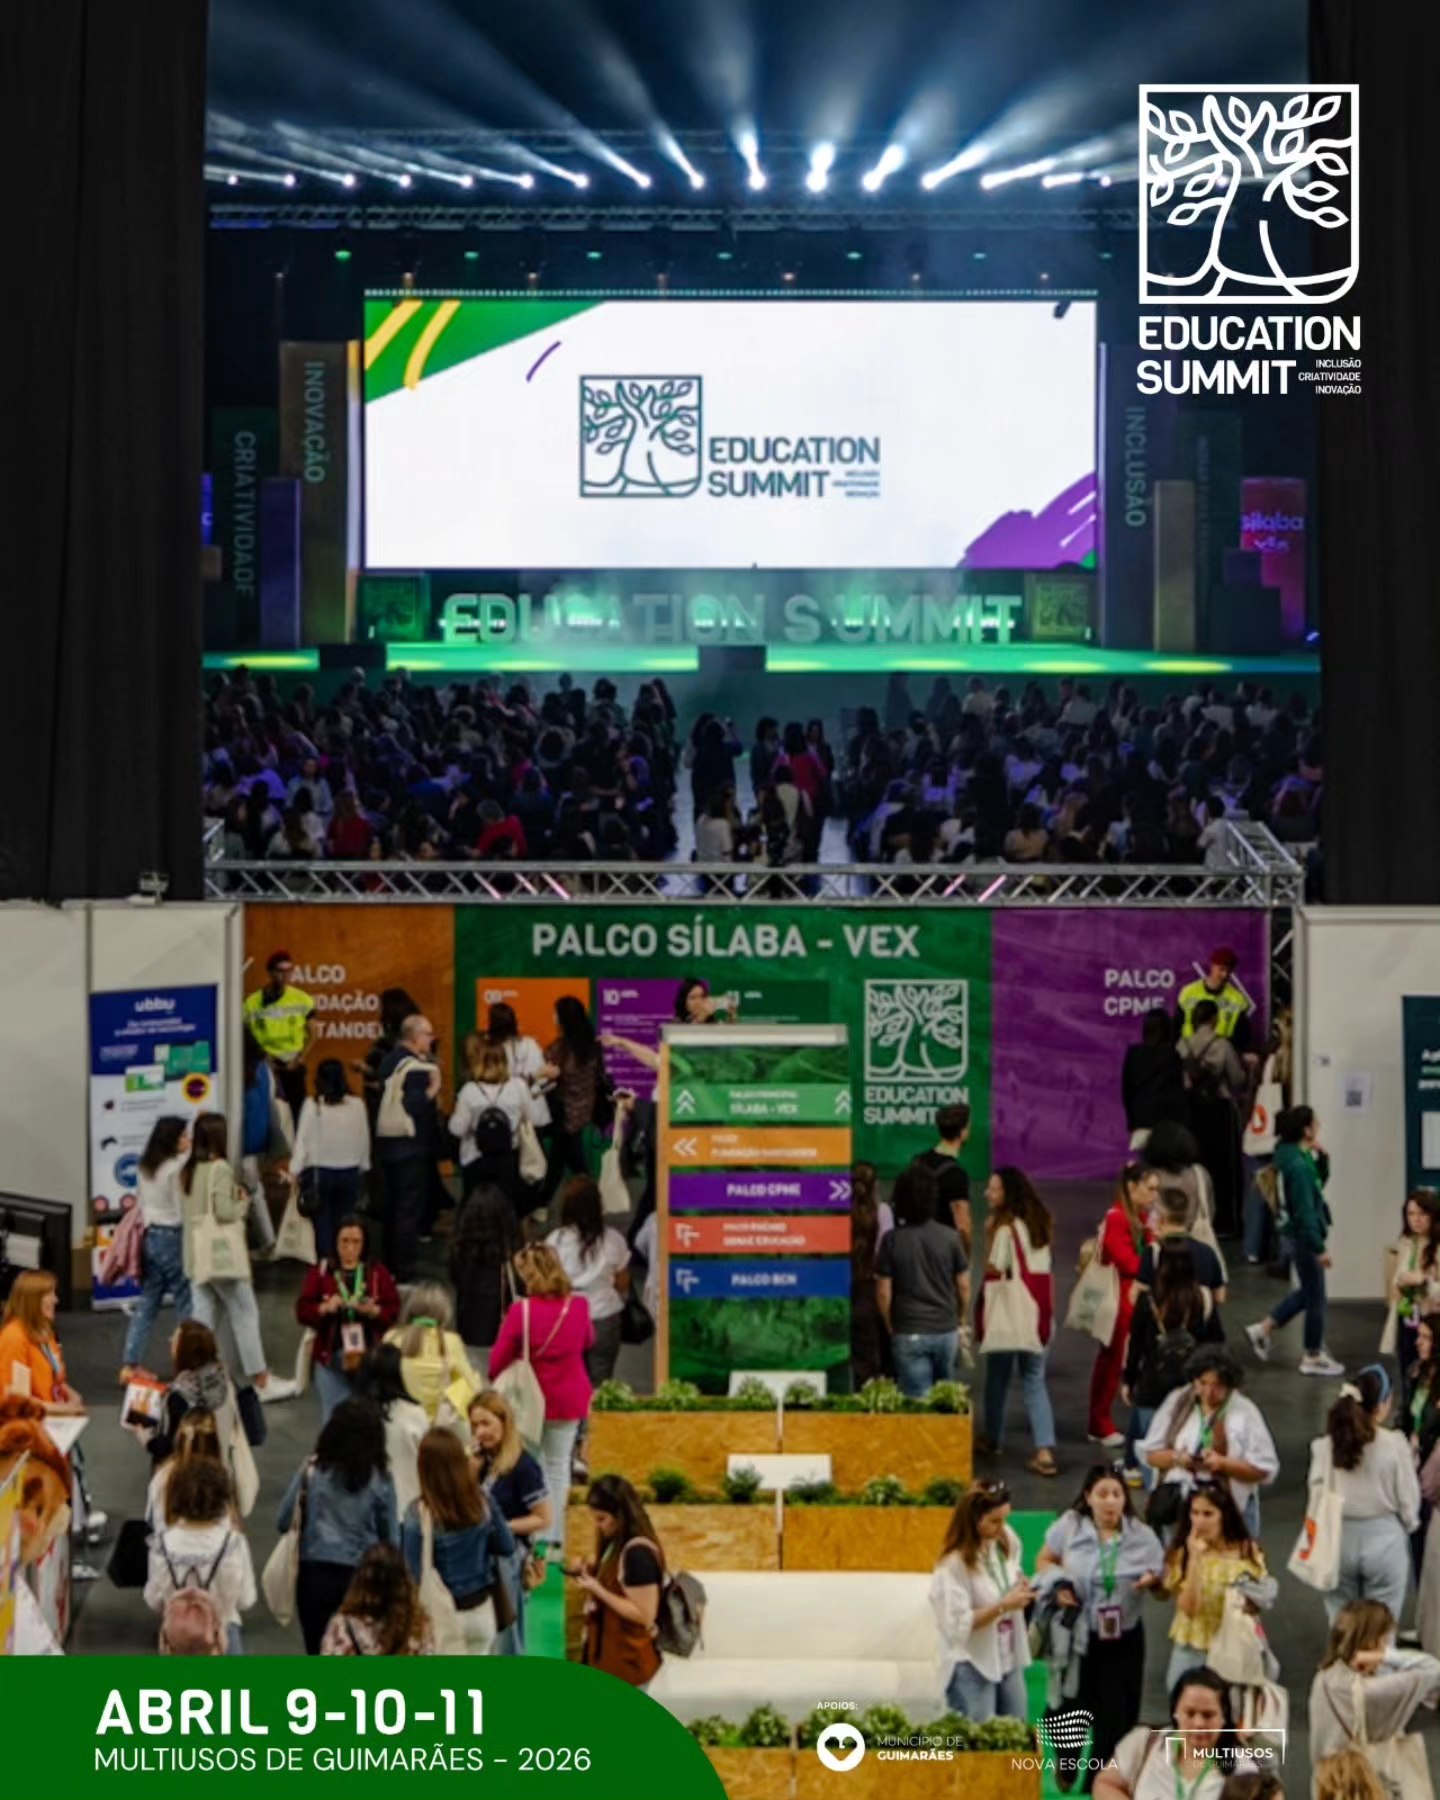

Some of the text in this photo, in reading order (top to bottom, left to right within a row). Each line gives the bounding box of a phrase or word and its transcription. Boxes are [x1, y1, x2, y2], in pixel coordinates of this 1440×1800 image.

[302, 361, 330, 484] INOVAÇÃO
[708, 436, 880, 465] EDUCATION
[707, 470, 831, 498] SUMMIT
[443, 593, 765, 644] EDUCATION
[531, 923, 658, 957] PALCO
[667, 914, 806, 957] SÍLABA
[843, 924, 921, 957] VEX
[289, 964, 347, 984] ALCO
[1104, 969, 1176, 989] PALCO
[864, 1086, 969, 1104] EDUCATION
[864, 1106, 938, 1125] SUMMIT
[726, 1183, 767, 1197] PALCO
[730, 1273, 770, 1286] PALCO
